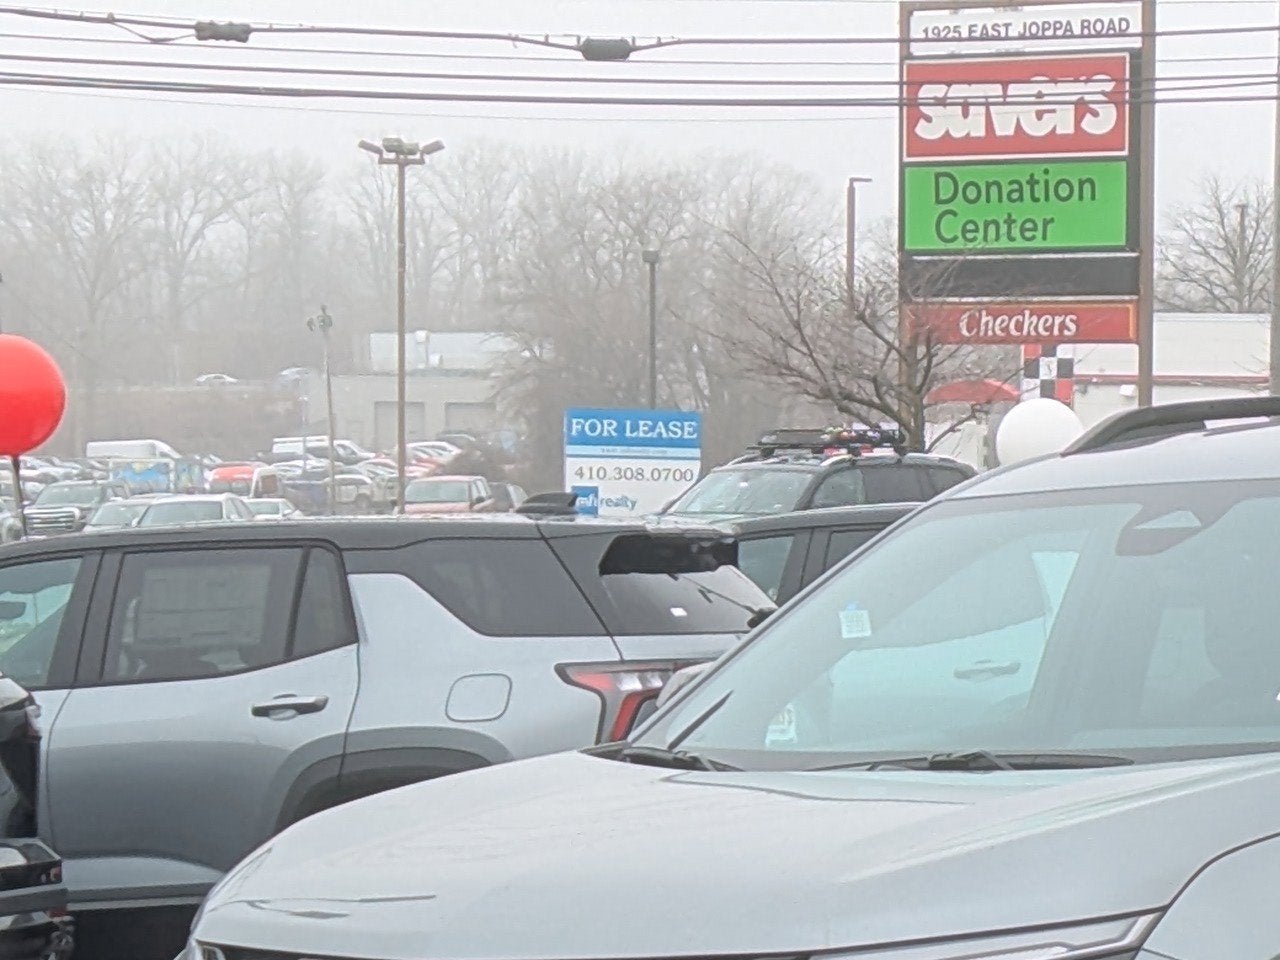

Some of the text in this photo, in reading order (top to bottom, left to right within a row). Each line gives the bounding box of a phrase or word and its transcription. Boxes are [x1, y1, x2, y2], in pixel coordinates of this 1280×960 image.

[922, 17, 1131, 40] 1925 EAST JOPPA ROAD
[933, 168, 1097, 205] Donation
[934, 208, 1056, 244] Center
[959, 308, 1078, 338] Checkers
[571, 418, 698, 440] FOR LEASE
[574, 465, 694, 483] 410.308.0700
